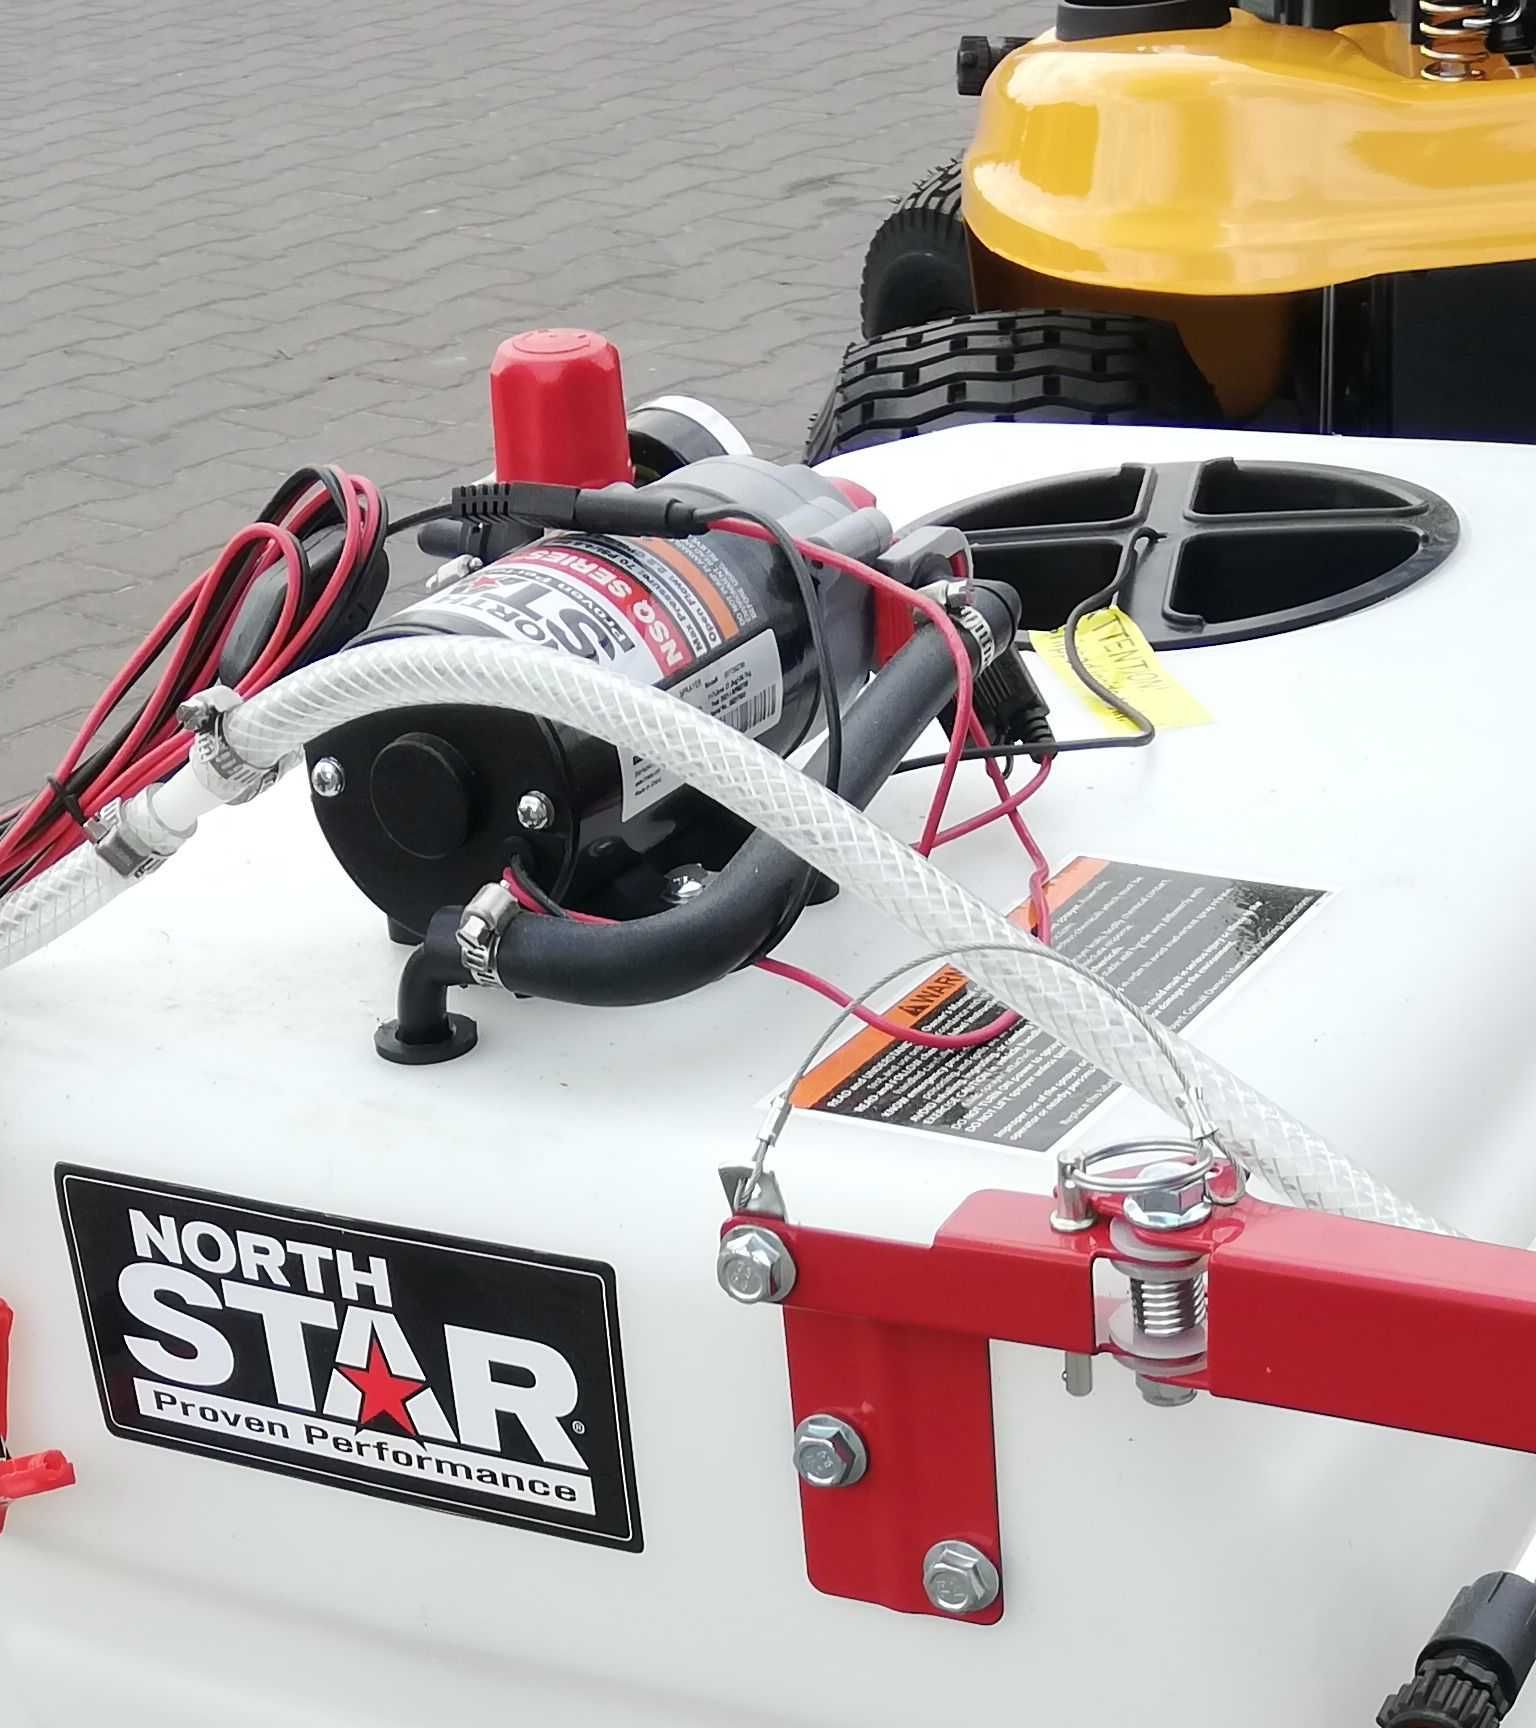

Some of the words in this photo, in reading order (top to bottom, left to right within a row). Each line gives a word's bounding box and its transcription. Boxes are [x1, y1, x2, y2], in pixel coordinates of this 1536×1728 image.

[523, 549, 632, 599] SERIES
[559, 582, 627, 642] Proven
[632, 599, 684, 667] NSQ
[696, 607, 717, 642] Open
[685, 624, 703, 652] Max
[910, 967, 966, 1008] WARN
[956, 1071, 991, 1097] CAUTION
[950, 1118, 967, 1130] DO
[964, 1121, 981, 1132] DO
[976, 1108, 996, 1122] NOT
[127, 1208, 393, 1309] NORTH
[116, 1260, 590, 1472] STAR
[154, 1389, 290, 1441] Proven
[304, 1423, 578, 1504] Performance
